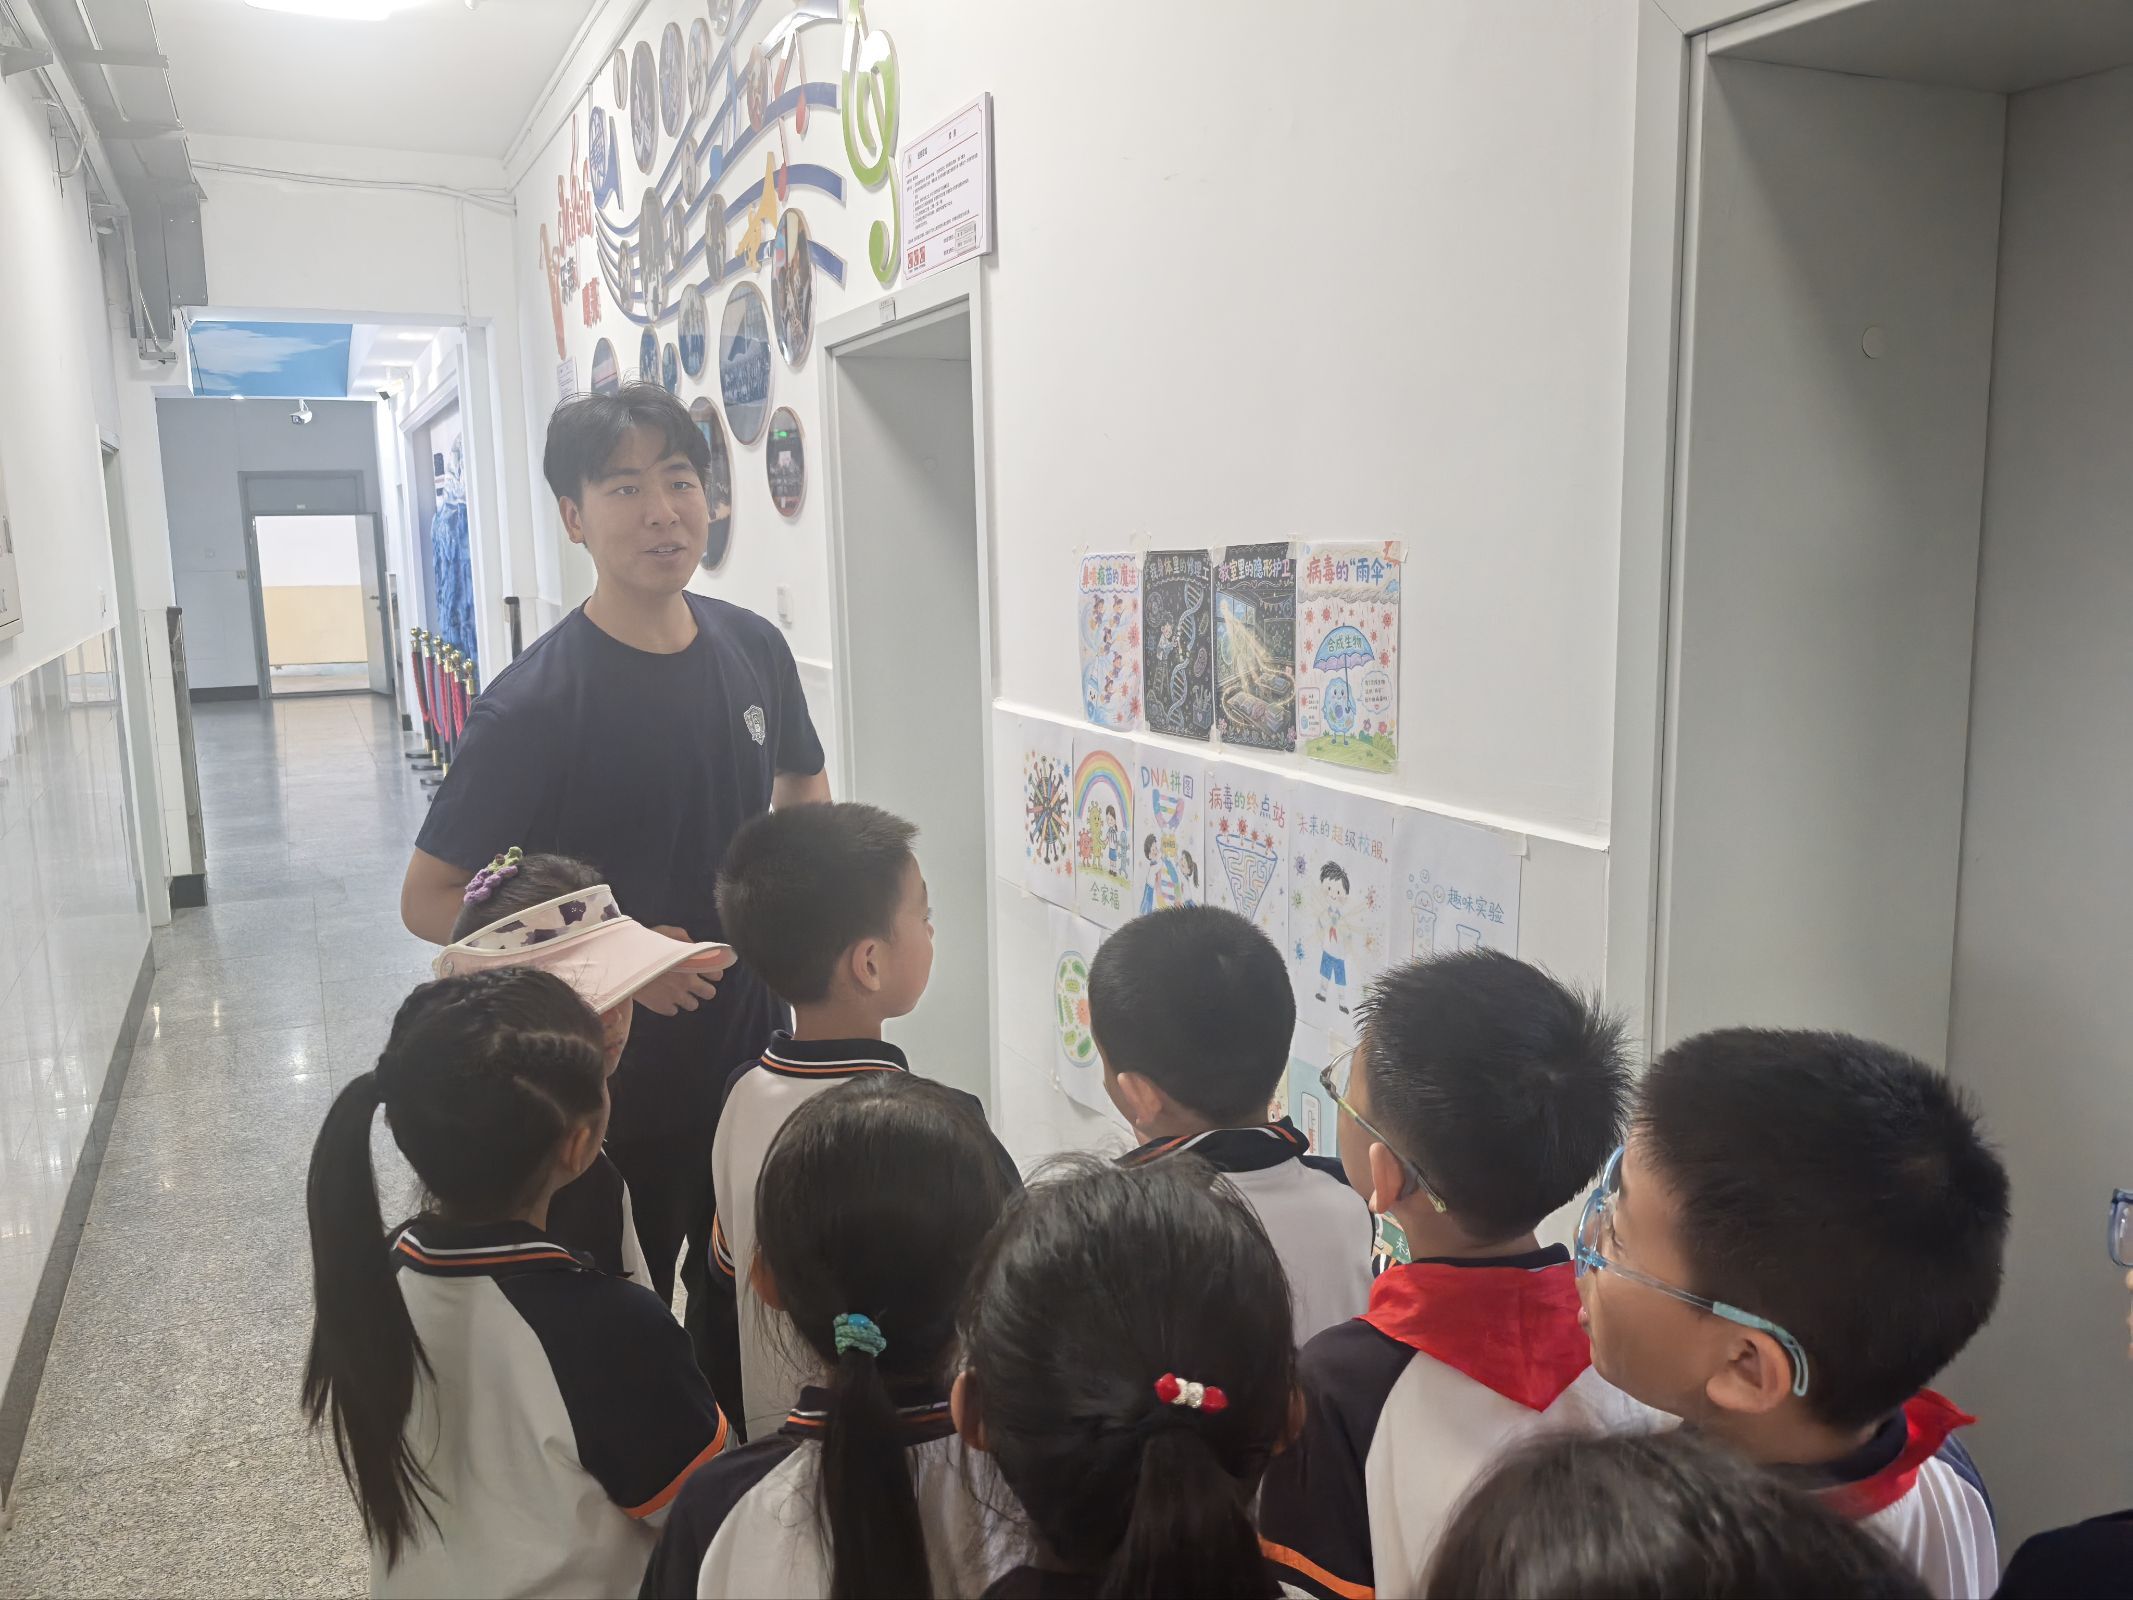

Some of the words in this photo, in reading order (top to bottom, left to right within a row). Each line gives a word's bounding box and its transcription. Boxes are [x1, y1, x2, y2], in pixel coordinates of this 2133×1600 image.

[1218, 556, 1291, 583] 教室里的隐形护卫
[1327, 635, 1363, 652] 合成生物
[1140, 765, 1194, 801] DNA拼图
[1208, 783, 1286, 828] 病毒的终点站
[1089, 881, 1121, 910] 全家福
[1446, 886, 1505, 925] 趣味实验
